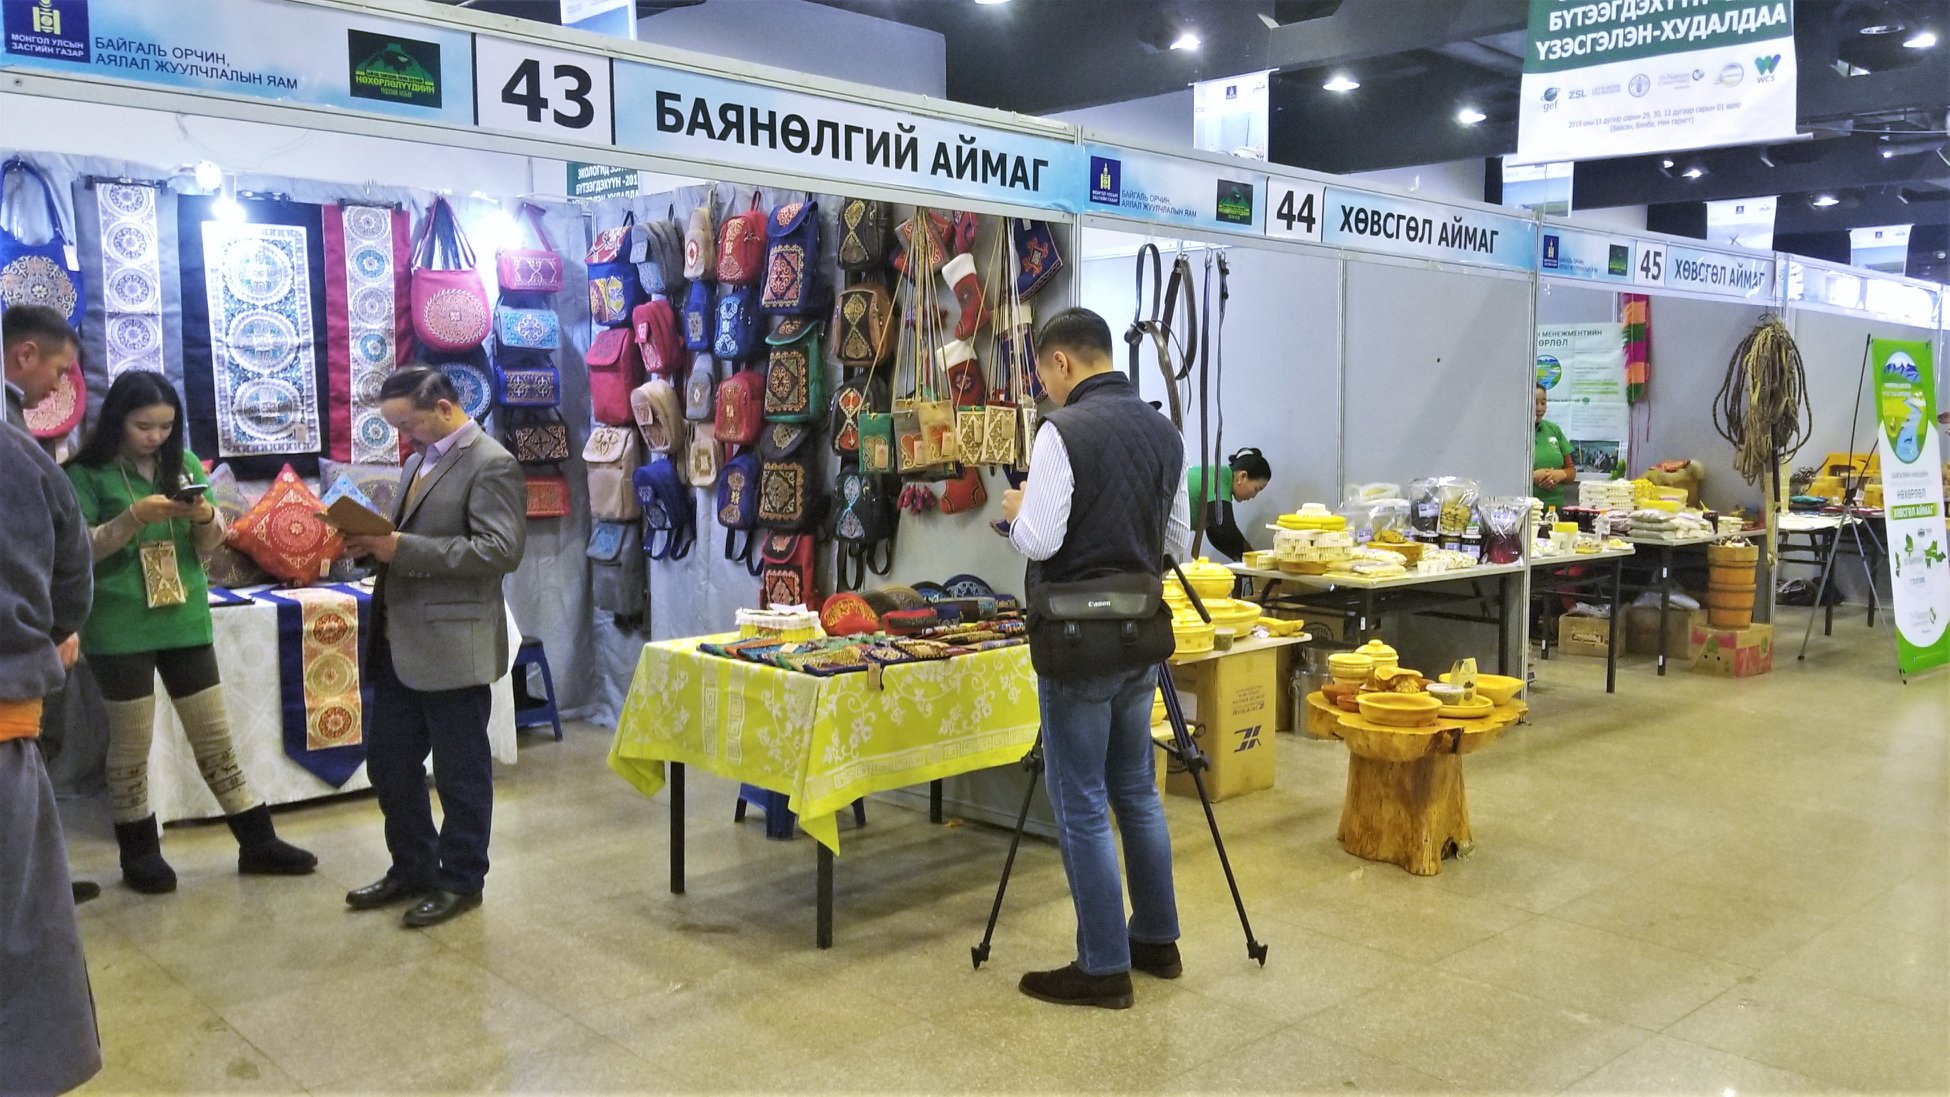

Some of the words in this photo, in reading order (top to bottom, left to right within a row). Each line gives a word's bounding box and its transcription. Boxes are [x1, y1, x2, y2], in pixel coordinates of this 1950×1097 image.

[1550, 0, 1709, 31] БҮТЭЭГДЭХҮ
[11, 33, 50, 45] МОНГОЛ
[52, 38, 84, 50] УЛСЫН
[1535, 3, 1787, 61] ҮЗЭСГЭЛЭН-ХУДАЛДАА
[12, 42, 54, 53] ЗАСГИЙН
[56, 48, 84, 57] ГАЗАР
[95, 36, 167, 57] БАЙГАЛЬ
[172, 47, 230, 67] ОРЧИН,
[95, 53, 150, 71] АЯЛАЛ
[155, 59, 262, 85] ЖУУЛЧЛАЛЫН
[267, 75, 298, 90] ЯАМ
[1757, 75, 1775, 84] WCS
[1568, 89, 1587, 99] ZSL
[1543, 99, 1559, 113] gef
[501, 58, 595, 129] 43
[655, 90, 918, 173] БАЯНӨЛГИЙ
[931, 134, 1049, 193] АЙМАГ
[576, 176, 621, 195] БҮТЭЭГДЭХҮҮН
[1122, 189, 1148, 202] БАЙГАЛЬ
[1149, 194, 1172, 206] ОРЧИН,
[1121, 199, 1142, 210] АЯЛАЛ
[1184, 209, 1197, 218] ЯАМ
[1276, 190, 1316, 233] 44
[1338, 204, 1432, 246] ХӨВСГӨЛ
[1438, 217, 1499, 254] АЙМАГ
[1640, 249, 1662, 281] 45
[1674, 258, 1726, 285] ХӨВСГӨЛ
[1729, 262, 1765, 290] АЙМАГ
[1542, 329, 1602, 338] МЕНЕЖМЕНТИЙН
[1088, 600, 1111, 608] Canon
